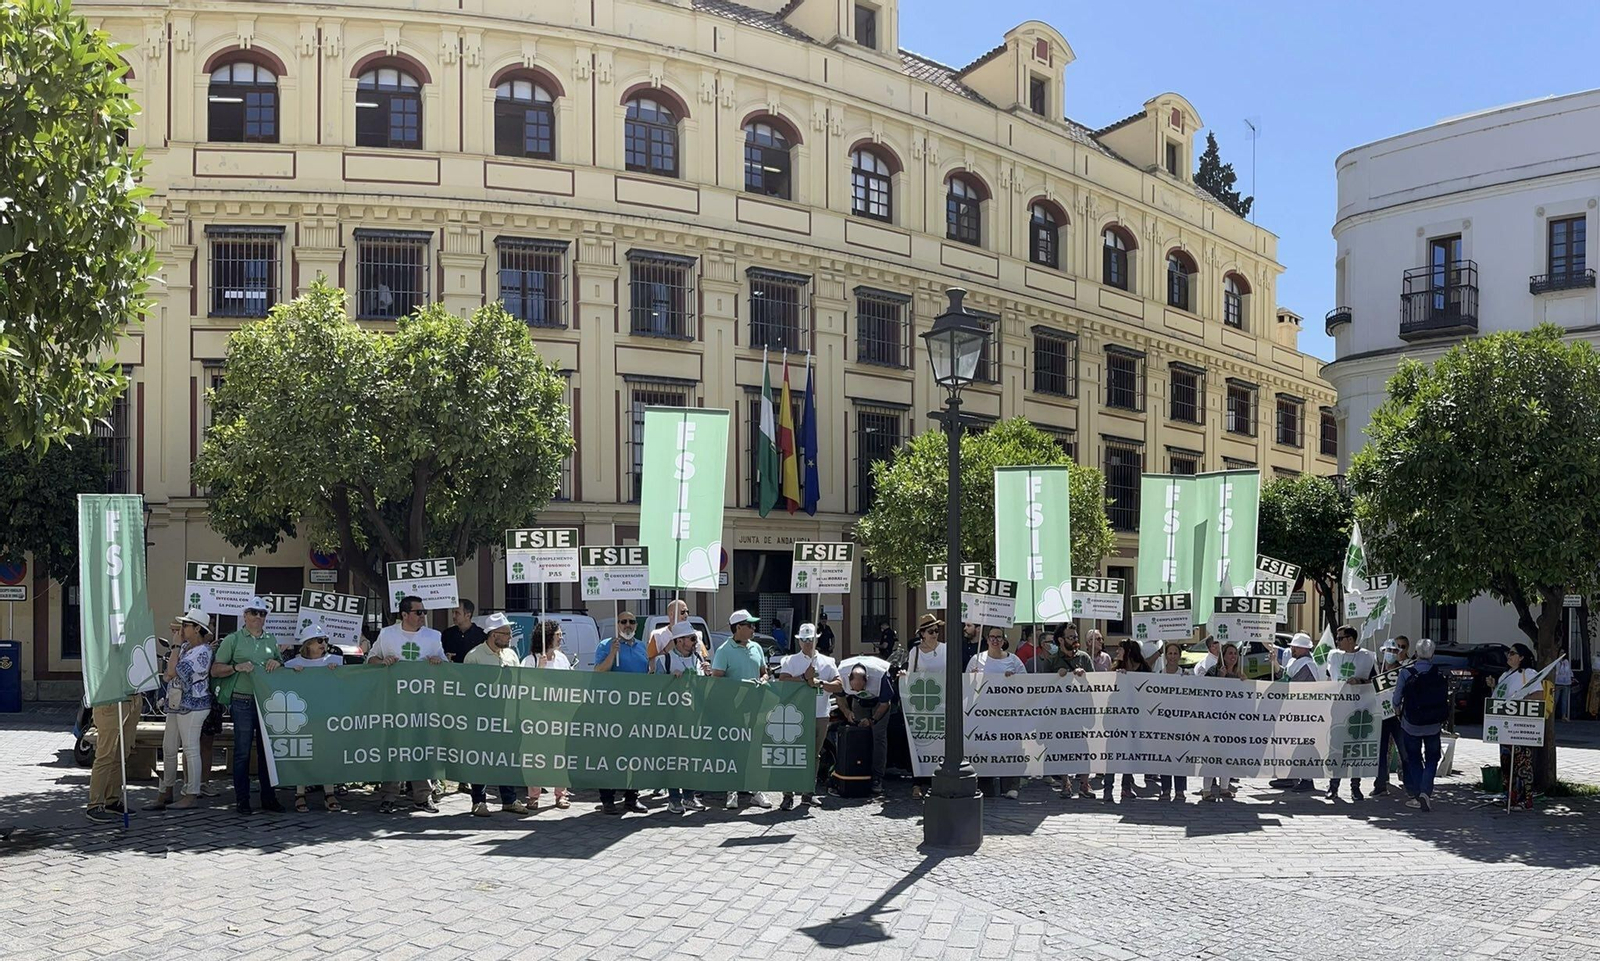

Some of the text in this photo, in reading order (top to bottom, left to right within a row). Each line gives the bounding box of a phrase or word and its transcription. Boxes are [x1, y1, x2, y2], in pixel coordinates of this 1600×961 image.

[672, 422, 696, 539] FSIE
[1025, 476, 1044, 580] FSIE
[1162, 485, 1180, 583] FSIE
[515, 531, 570, 548] FSIE
[739, 535, 760, 544] JUNTA
[764, 536, 772, 544] DE
[589, 548, 642, 565] FSIE
[801, 544, 848, 561] FSIE
[196, 564, 250, 583] FSIE
[396, 560, 449, 579] FSIE
[1259, 557, 1296, 579] FSIE
[106, 510, 126, 645] FSIE
[963, 576, 1011, 597] FSIE
[1076, 578, 1118, 593] FSIE
[1256, 581, 1284, 596] FSIE
[261, 596, 298, 613] SIE
[308, 591, 359, 614] FSIE
[1139, 595, 1185, 611] FSIE
[1221, 598, 1272, 613] FSIE
[1375, 671, 1399, 691] FS
[396, 679, 692, 707] POR EL CUMPLIMIENTO DE LOS
[986, 684, 1361, 701] ABONO DEUDA SALARIAL COMPLEMENTO PAS Y P. COMPLEMENTARIO
[974, 706, 1325, 723] CONCERTACIÓN BACHILLERATO EQUIPARACIÓN CON LA PÚBLICA
[1492, 699, 1539, 717] FSIE
[326, 712, 751, 742] COMPROMISOS DEL GOBIERNO ANDALUZ CON
[974, 731, 997, 741] MÁS
[1000, 731, 1037, 741] HORAS
[1039, 731, 1053, 740] DE
[1055, 728, 1128, 740] ORIENTACIÓN
[1139, 731, 1200, 742] EXTENSIÓN
[1203, 734, 1211, 743] A
[1213, 735, 1247, 744] TODOS
[1249, 736, 1268, 744] LOS
[1270, 737, 1316, 746] NIVELES
[270, 738, 313, 757] SIE
[762, 747, 807, 765] FSIE
[1342, 743, 1377, 758] FSIE
[343, 746, 738, 773] LOS PROFESIONALES DE LA CONCERTADA
[991, 755, 1030, 763] RATIOS
[1045, 752, 1097, 762] AUMENTO
[1100, 753, 1113, 761] DE
[1116, 753, 1172, 762] PLANTILLA
[1185, 755, 1222, 765] MENOR
[1225, 757, 1261, 767] CARGA
[1263, 755, 1338, 767] BUROCRÁTICA
